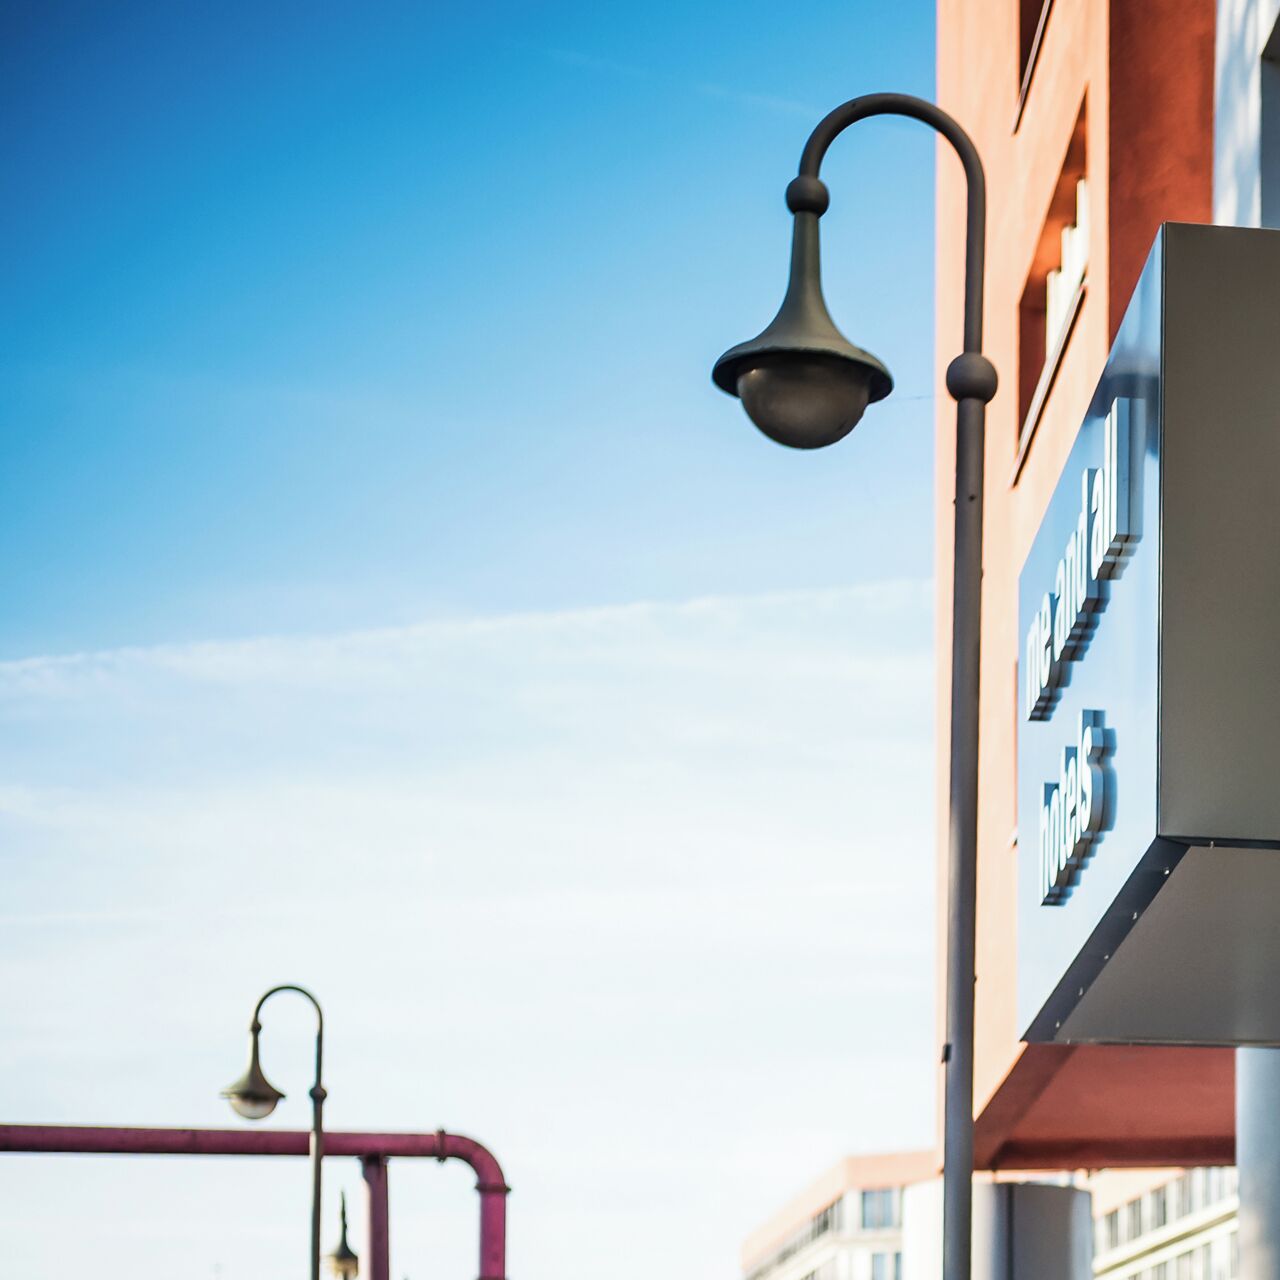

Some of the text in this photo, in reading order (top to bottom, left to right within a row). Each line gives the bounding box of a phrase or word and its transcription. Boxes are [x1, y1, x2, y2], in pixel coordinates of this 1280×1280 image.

[1025, 396, 1124, 722] me and all
[1038, 708, 1098, 906] hotels
